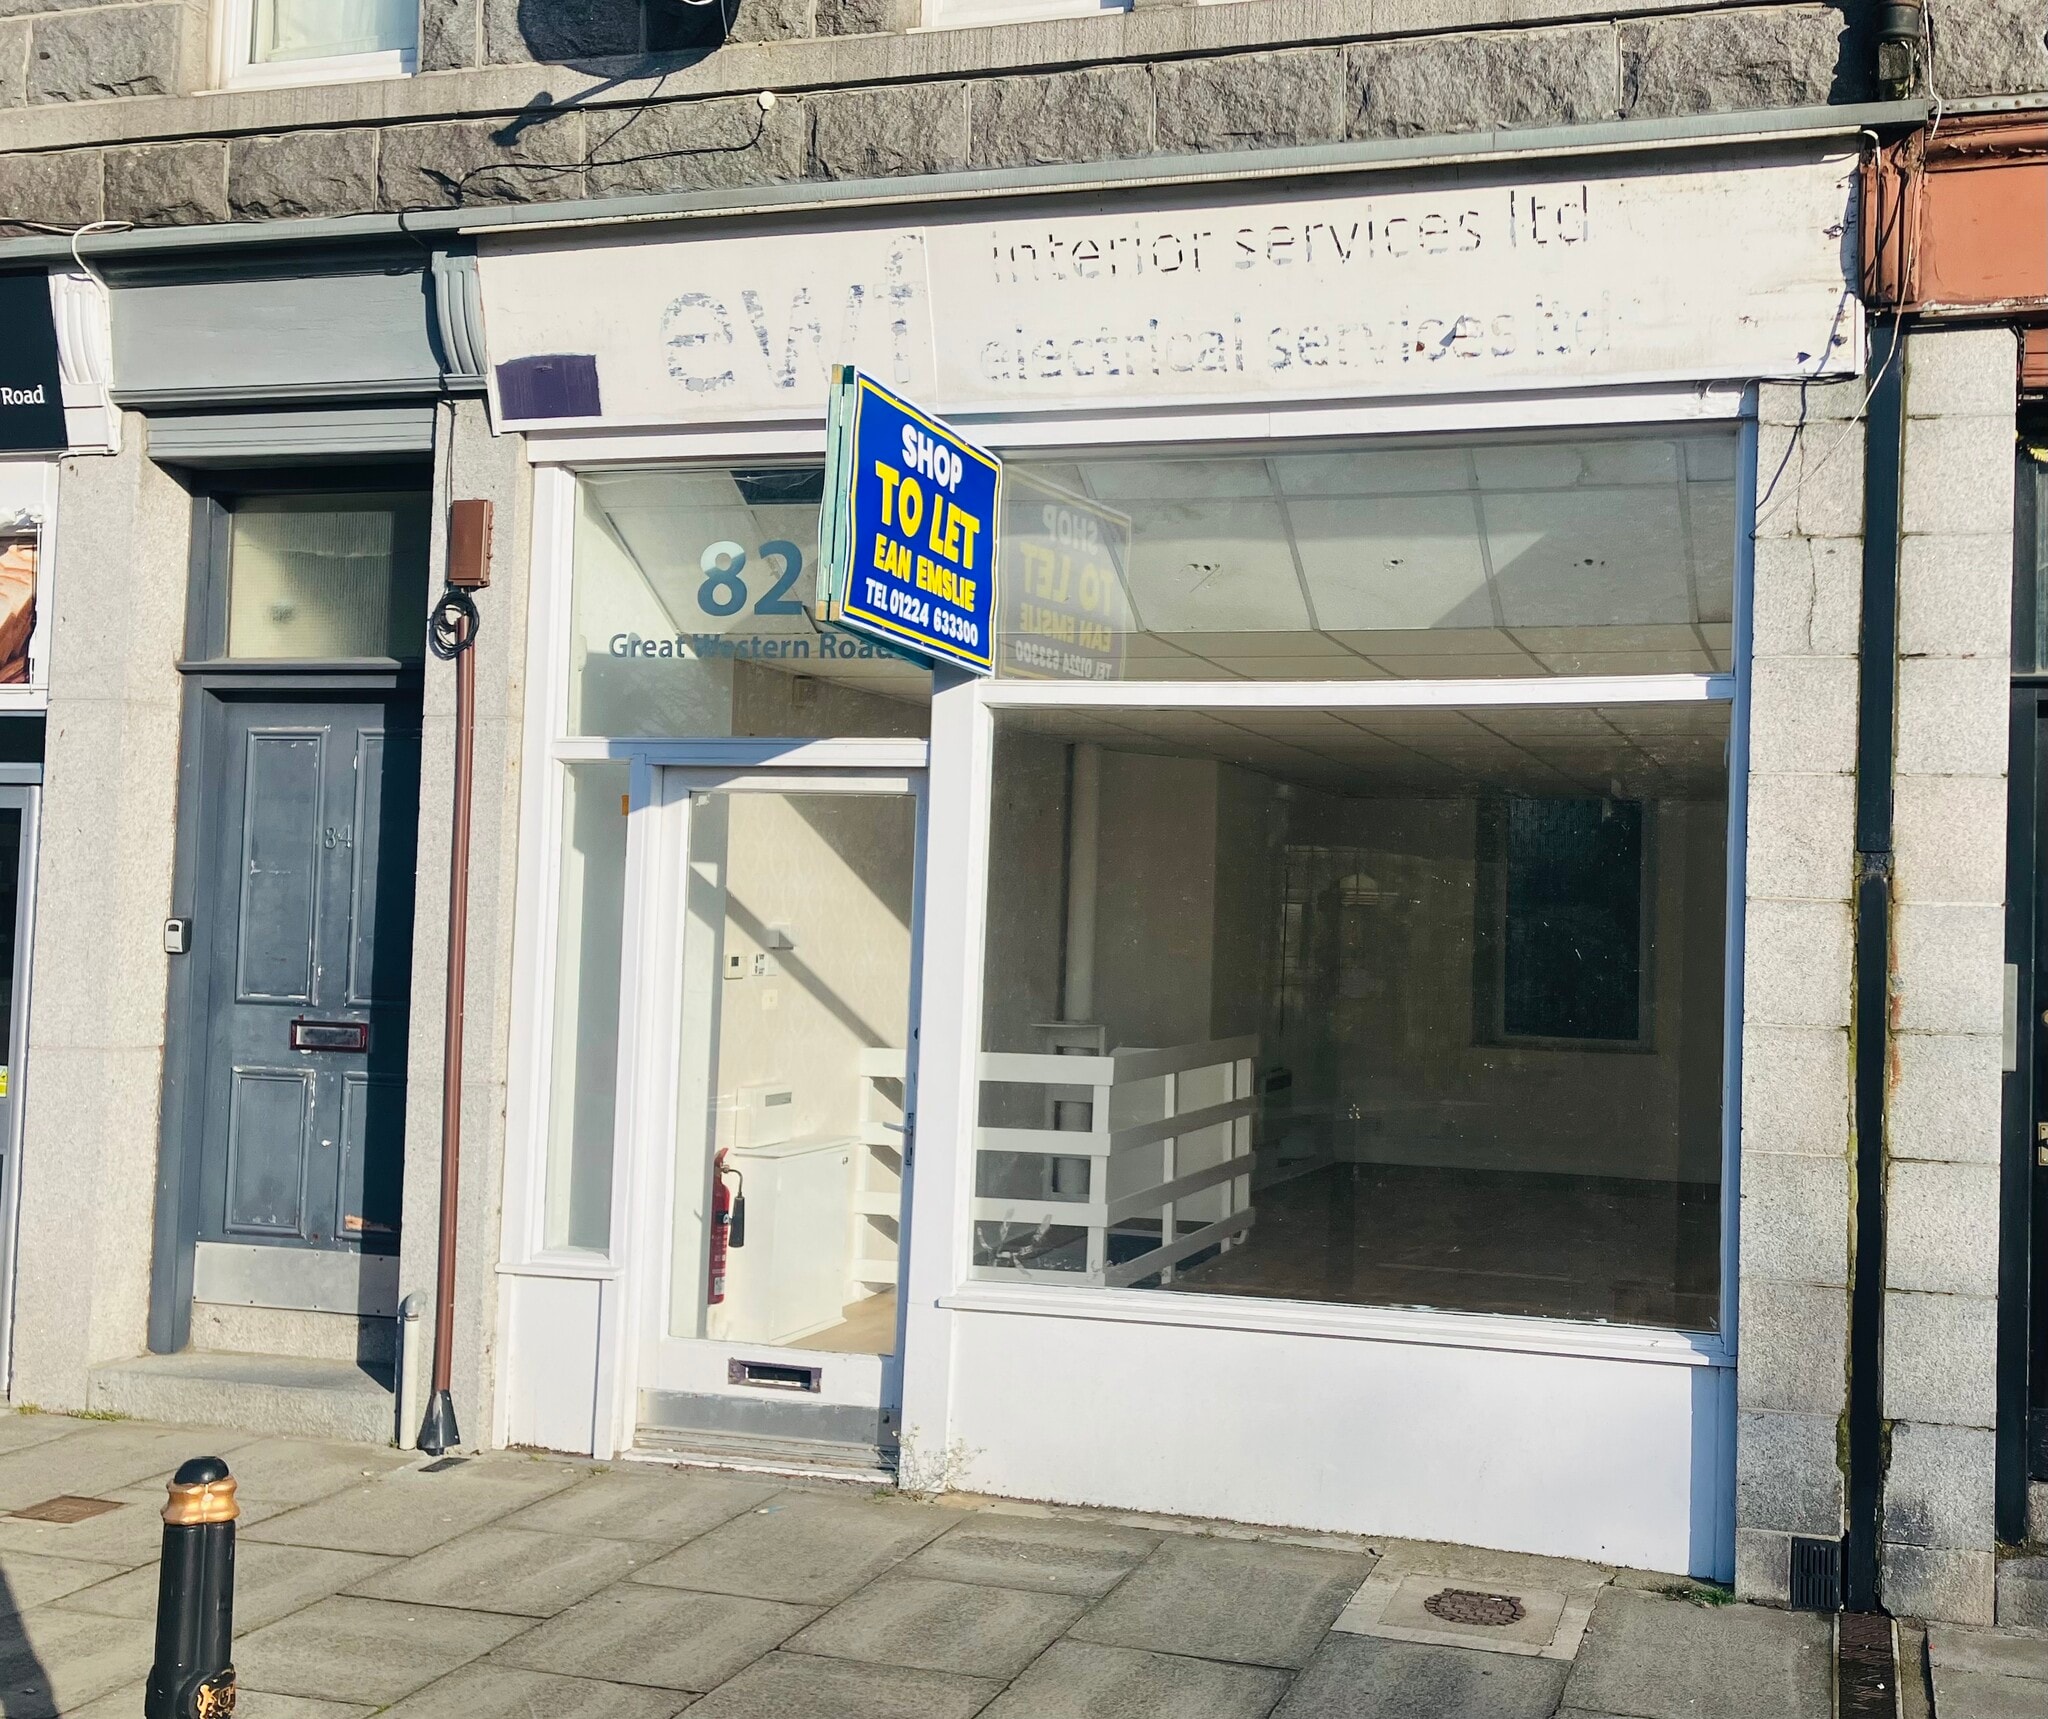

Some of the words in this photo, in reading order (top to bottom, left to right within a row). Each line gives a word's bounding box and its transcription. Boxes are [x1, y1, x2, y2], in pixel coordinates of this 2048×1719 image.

[991, 220, 1212, 284] interior
[1234, 203, 1483, 270] services
[1510, 183, 1589, 249] ltd
[980, 311, 1246, 382] electrical
[1266, 303, 1517, 371] services
[0, 384, 45, 405] Road
[901, 423, 963, 494] SHOP
[875, 459, 924, 538] TO
[928, 493, 981, 570] LET
[697, 540, 803, 616] 82
[873, 532, 912, 583] EAN
[915, 554, 977, 613] EMSLIE
[609, 633, 685, 659] Great
[690, 633, 809, 660] Western
[865, 577, 888, 614] TEL
[890, 586, 930, 628] 01224
[933, 606, 979, 647] 633300
[325, 825, 352, 849] 84
